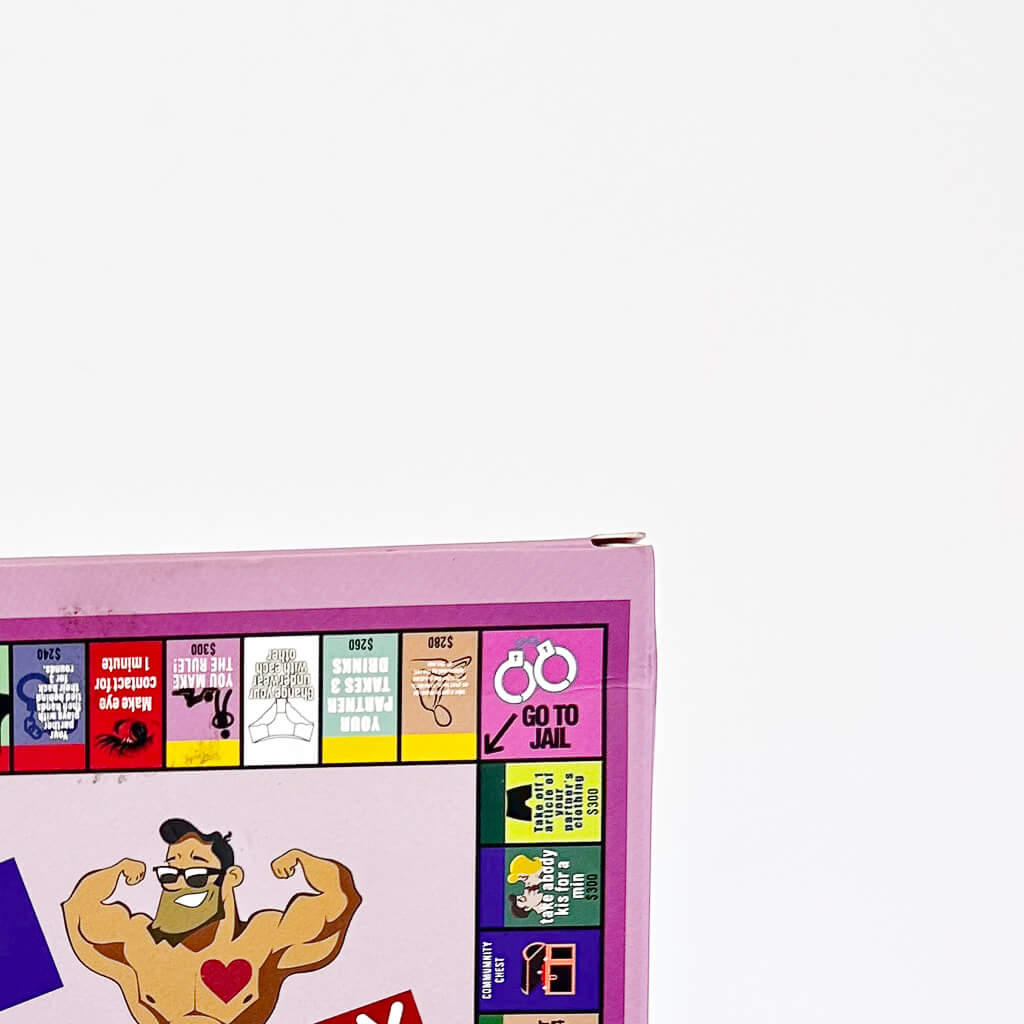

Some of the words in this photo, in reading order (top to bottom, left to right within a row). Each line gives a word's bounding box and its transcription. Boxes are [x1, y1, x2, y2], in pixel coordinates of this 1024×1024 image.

[191, 642, 216, 656] $300
[348, 638, 373, 651] $260
[428, 635, 453, 649] $280
[37, 648, 61, 661] $240
[102, 657, 142, 672] minute
[173, 657, 207, 673] RULE!
[210, 657, 232, 673] THE
[332, 656, 389, 674] DRINKS
[94, 677, 111, 692] for
[113, 676, 157, 692] contact
[173, 674, 206, 689] MAKE
[209, 673, 233, 689] YOU
[331, 677, 340, 694] 3
[344, 677, 391, 694] TAKES
[99, 693, 120, 710] eye
[122, 696, 152, 711] Make
[327, 696, 393, 713] PARTNER
[522, 705, 549, 726] GO
[553, 704, 579, 726] TO
[340, 715, 381, 732] YOUR
[530, 727, 571, 749] JAIL
[559, 861, 570, 869] a
[554, 871, 570, 891] for
[571, 873, 585, 898] min
[586, 874, 598, 900] $300
[540, 894, 555, 924] take
[554, 895, 570, 916] kis
